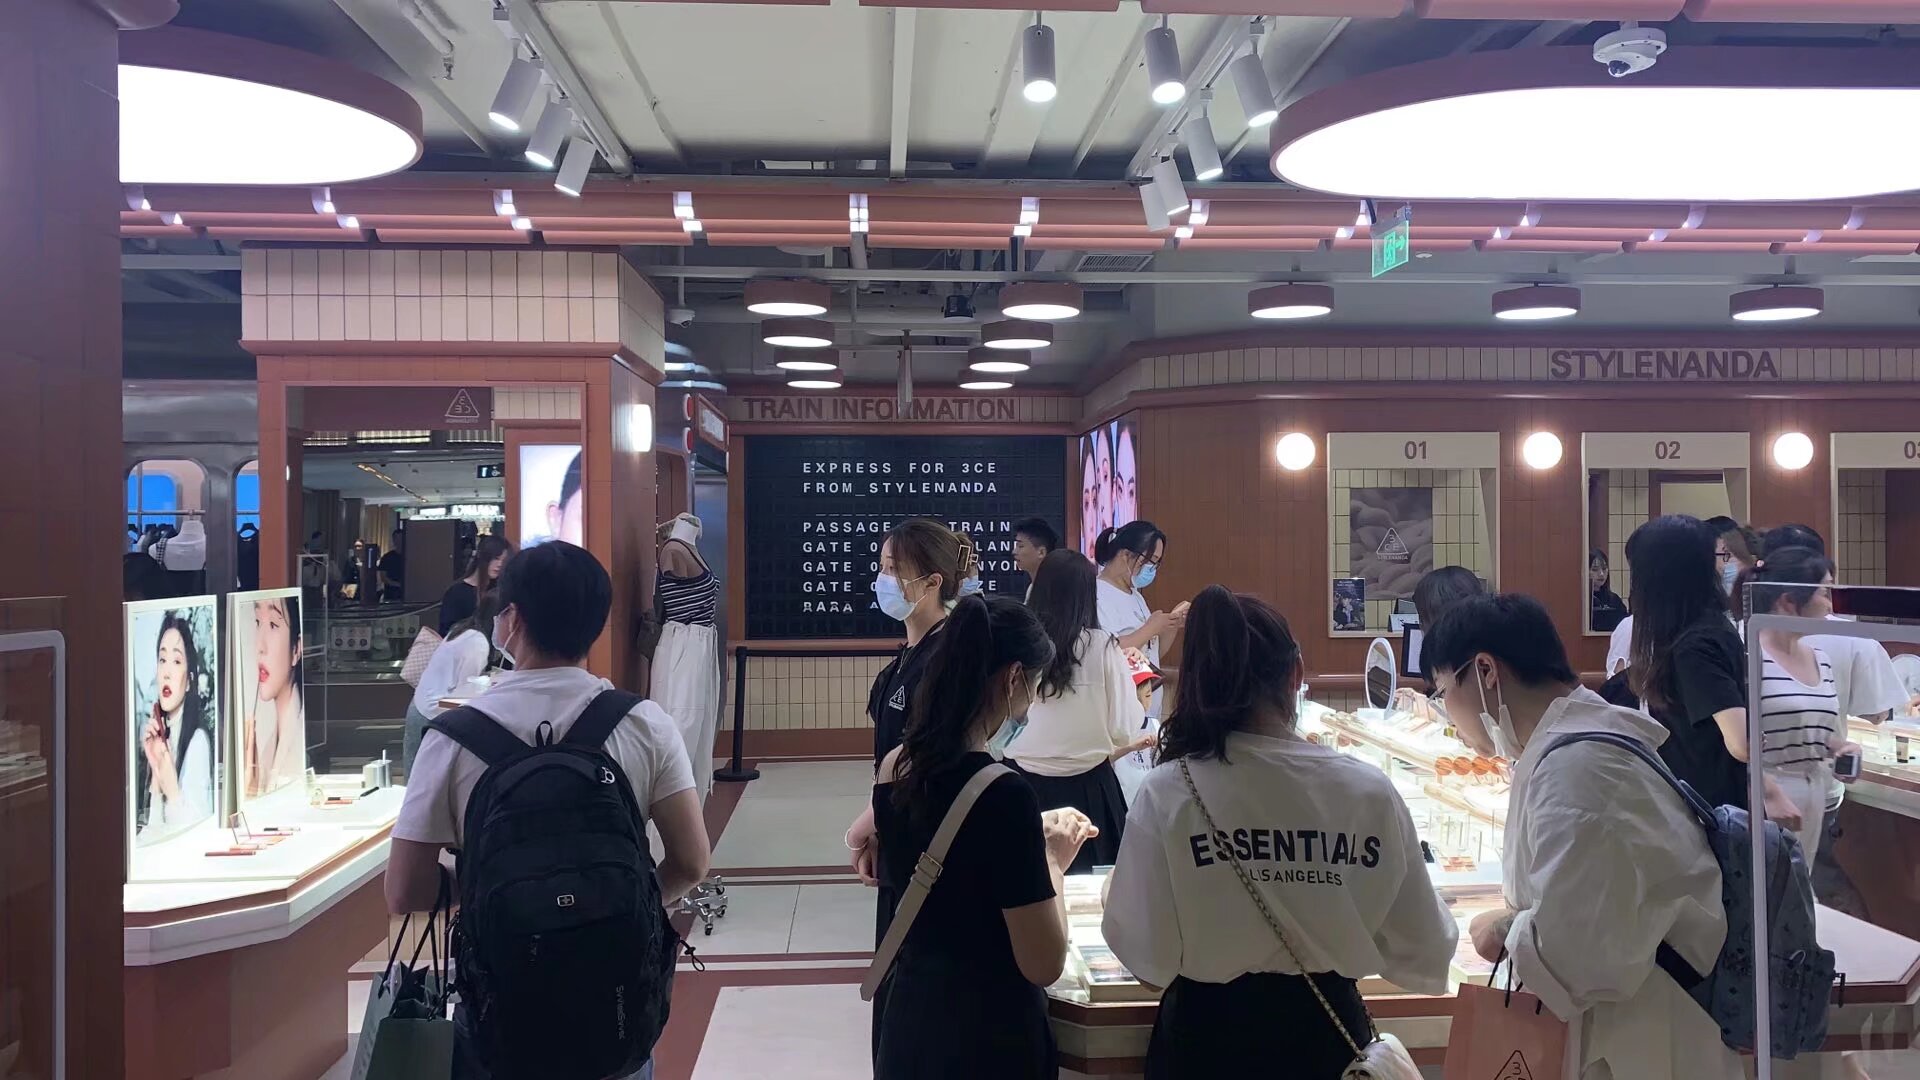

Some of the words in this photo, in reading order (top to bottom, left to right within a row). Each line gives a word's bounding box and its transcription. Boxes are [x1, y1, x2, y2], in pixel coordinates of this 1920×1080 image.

[1551, 350, 1778, 379] STYLENANDA
[744, 398, 823, 419] TRAIN
[1405, 441, 1426, 459] 01
[1655, 441, 1680, 459] 02
[803, 462, 891, 473] EXPRESS
[909, 462, 944, 473] FOR
[962, 462, 996, 473] 3CE
[803, 522, 891, 533] PASSAGE
[949, 521, 1010, 532] TRAIN
[803, 541, 852, 552] GATE
[803, 561, 852, 572] GATE
[803, 581, 852, 592] GATE
[1190, 828, 1381, 868] ESSENTIALS
[1274, 870, 1342, 886] ANGELES
